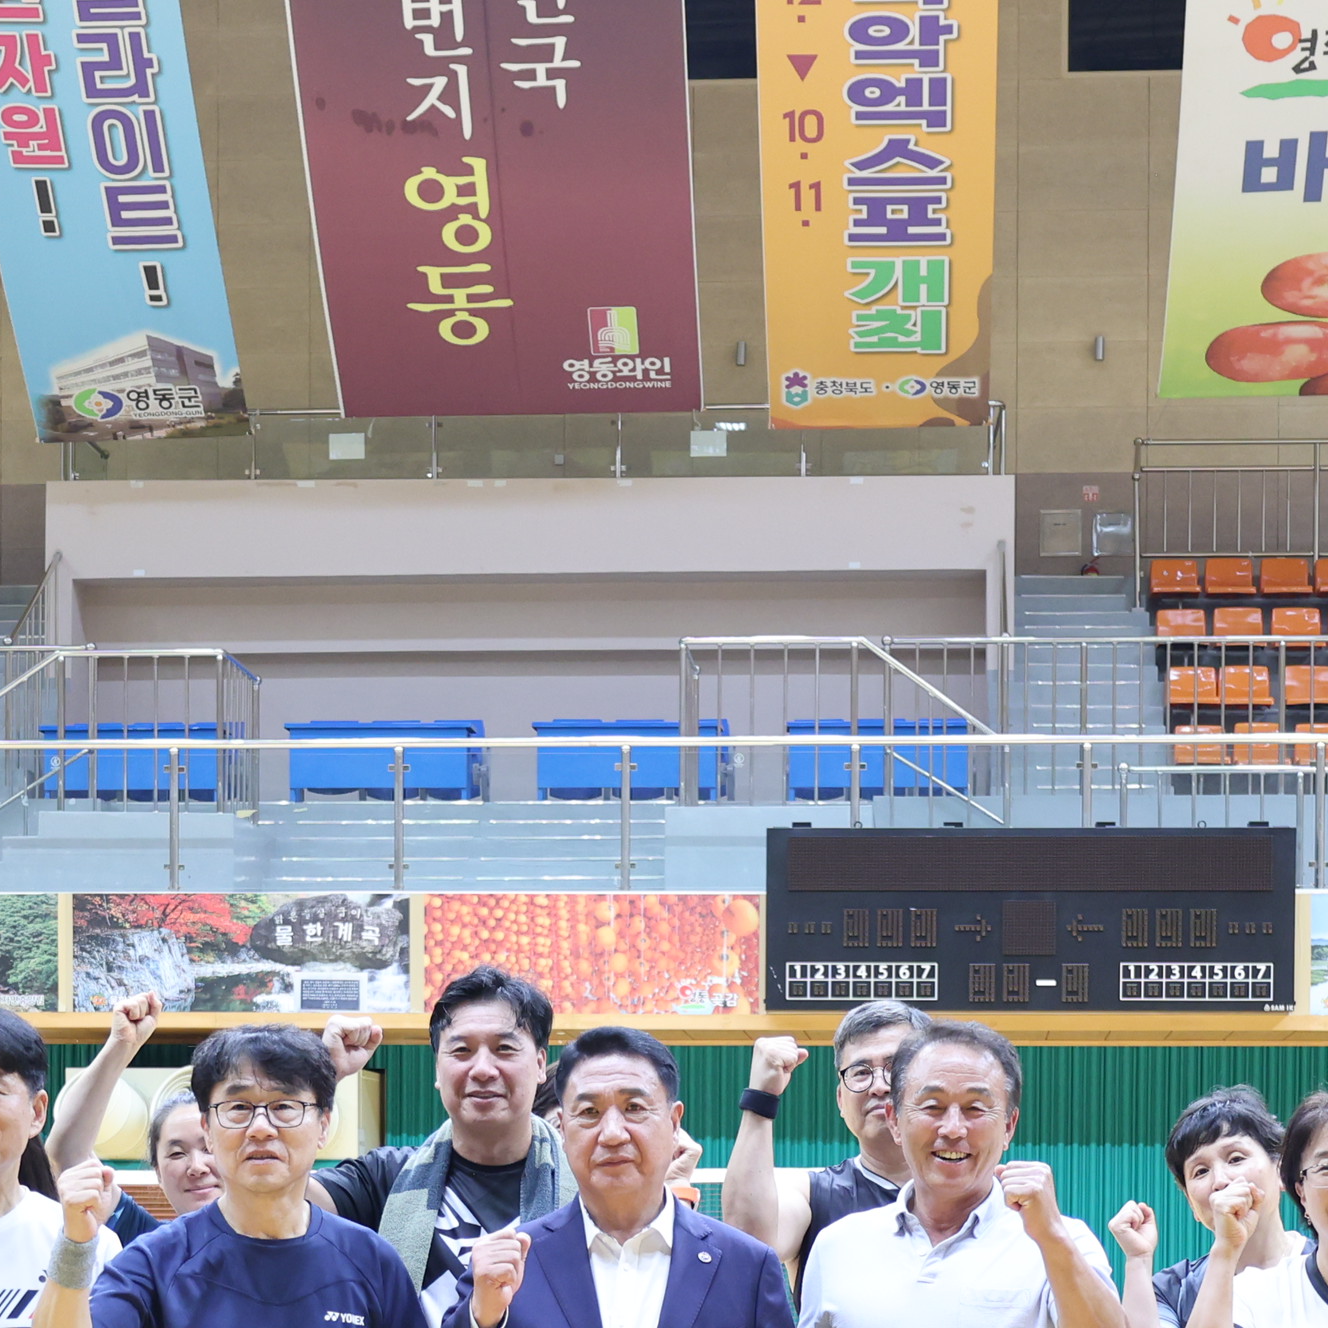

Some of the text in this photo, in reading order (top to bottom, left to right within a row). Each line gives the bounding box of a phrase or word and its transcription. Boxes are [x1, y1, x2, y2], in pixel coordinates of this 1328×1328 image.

[843, 0, 959, 354] 악엑스포 개최
[404, 156, 514, 346] 영동
[563, 356, 672, 382] 영동와인
[814, 379, 874, 396] 충청북도
[929, 379, 977, 396] 영동군
[126, 387, 202, 411] 영동군
[133, 411, 204, 419] YEONGDONG-GUN
[274, 921, 381, 946] 물한계곡
[814, 965, 825, 979] 2
[835, 965, 846, 979] 3
[856, 965, 868, 979] 4
[878, 965, 889, 979] 5
[899, 965, 910, 979] 6
[921, 965, 932, 979] 7
[1148, 966, 1159, 980] 2
[1170, 966, 1181, 980] 3
[1191, 966, 1203, 980] 4
[1213, 966, 1224, 980] 5
[1234, 966, 1246, 980] 6
[1256, 966, 1267, 980] 7
